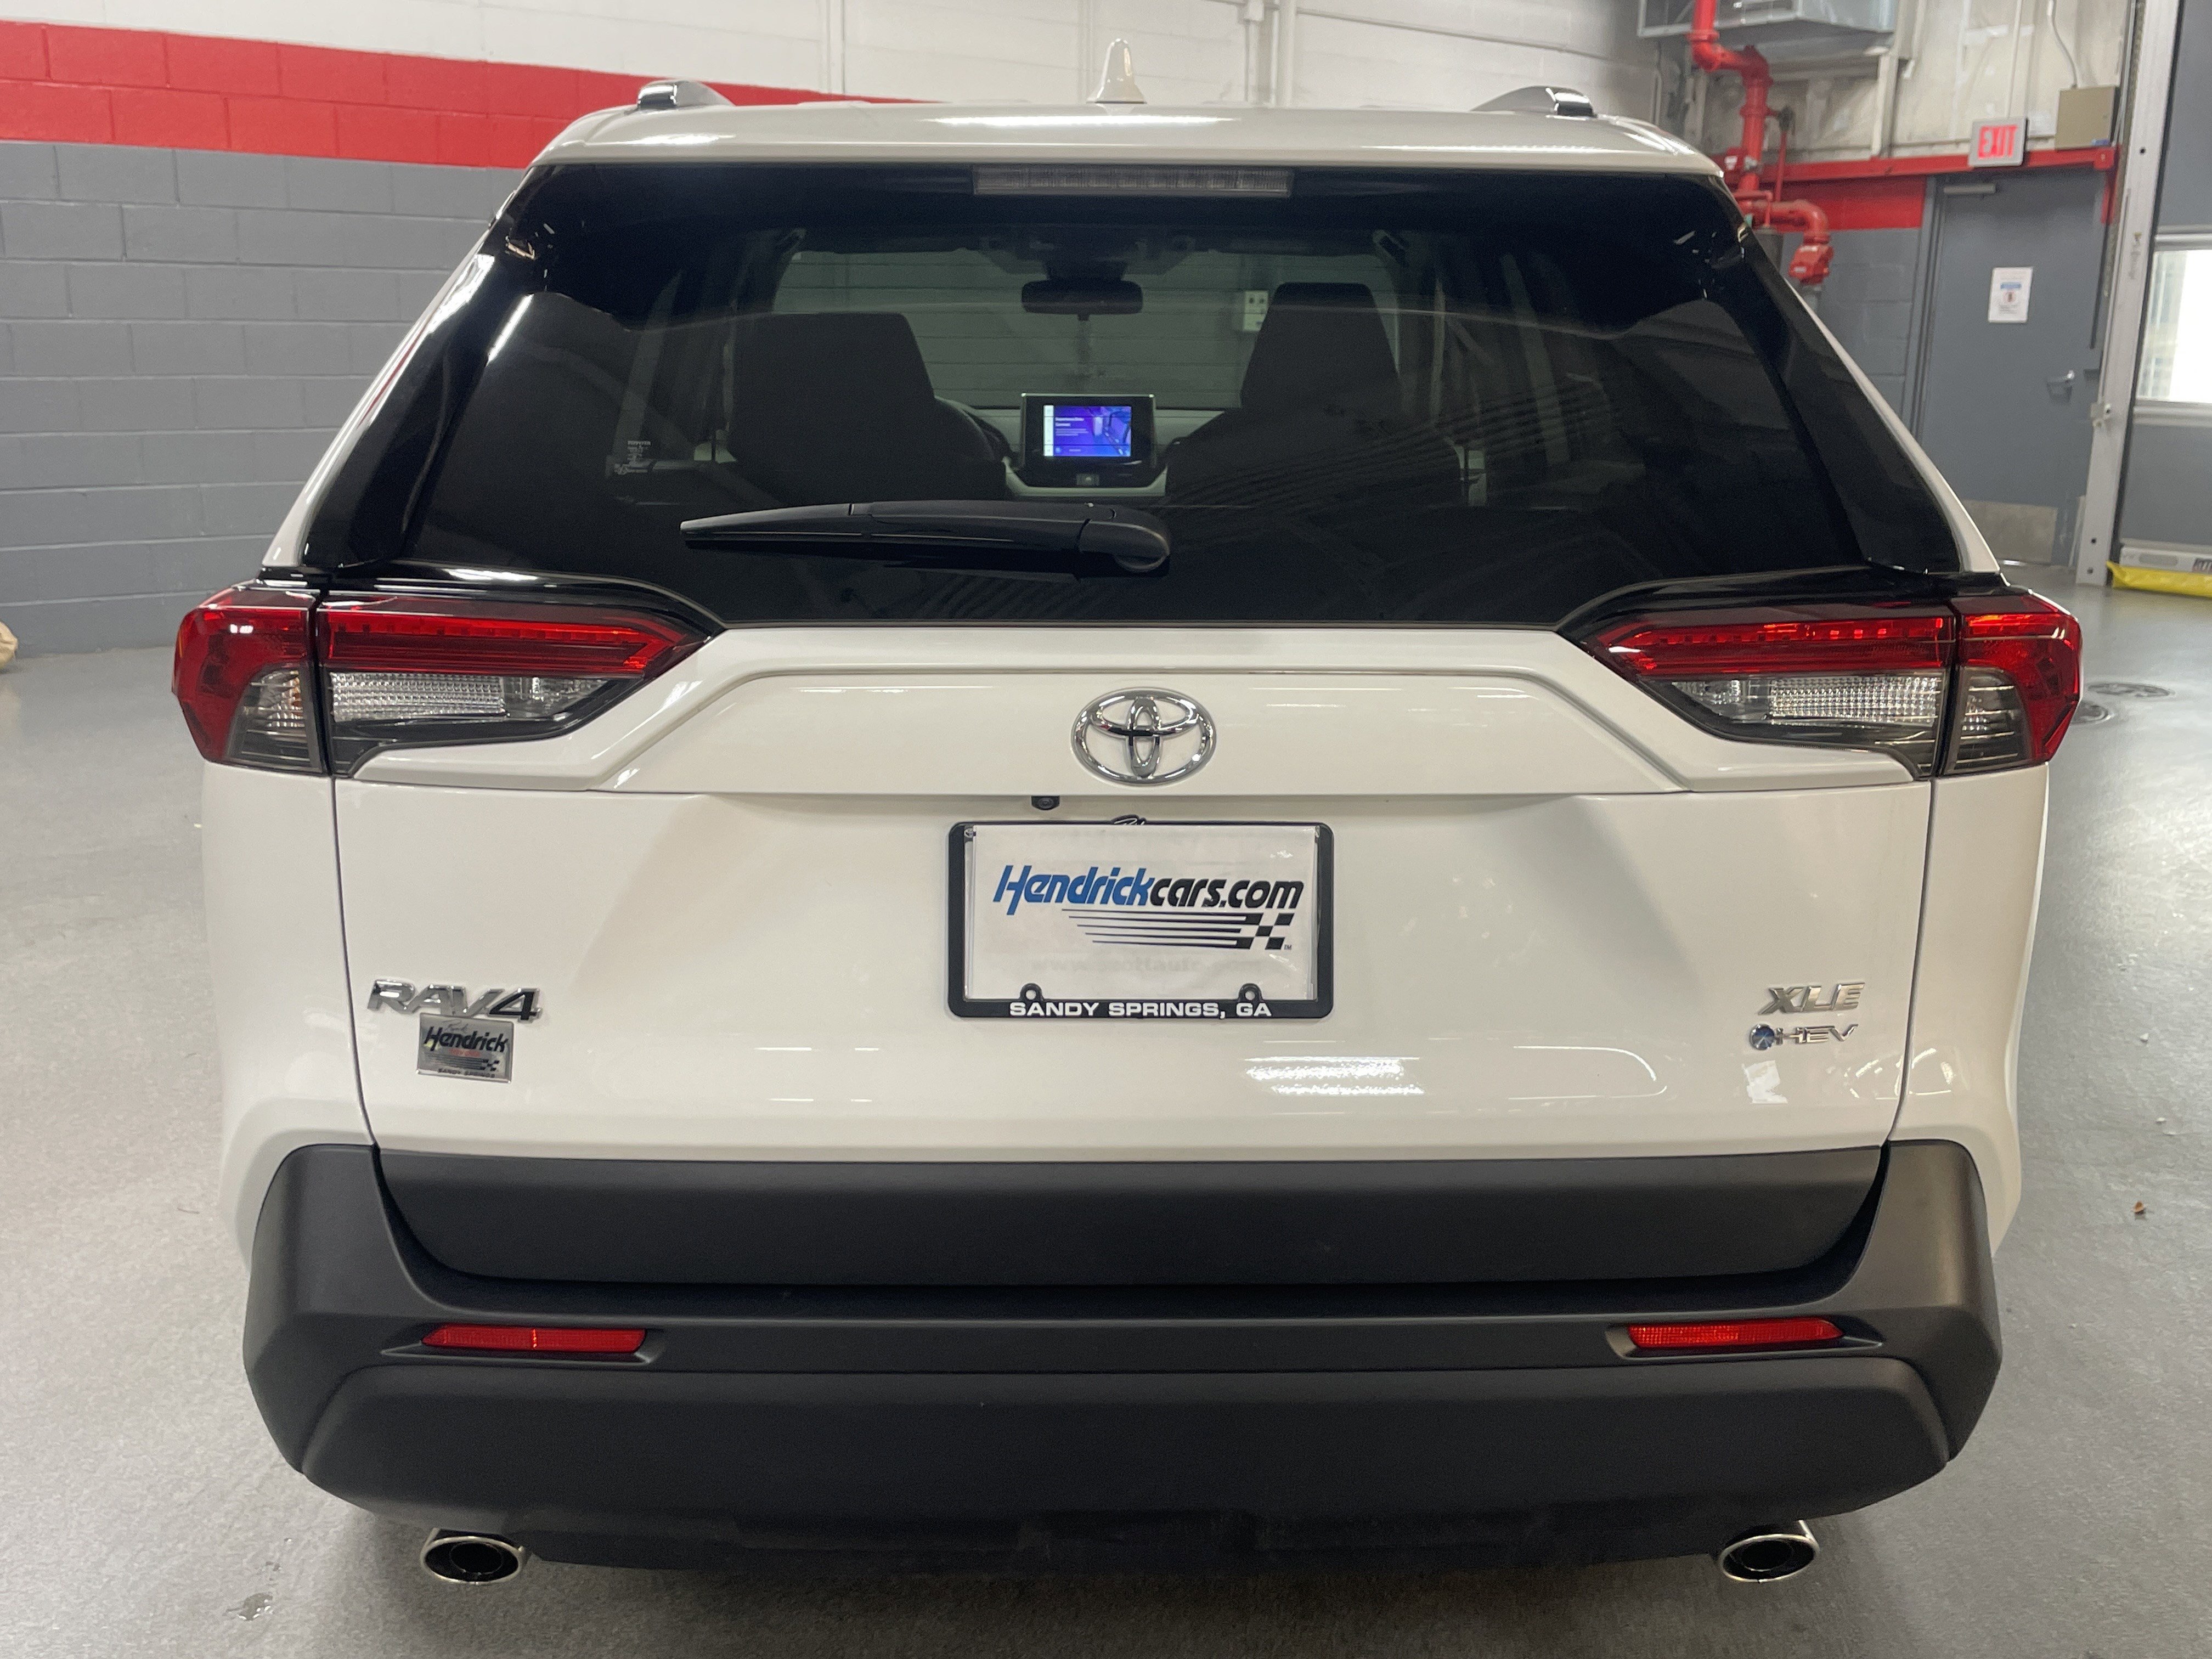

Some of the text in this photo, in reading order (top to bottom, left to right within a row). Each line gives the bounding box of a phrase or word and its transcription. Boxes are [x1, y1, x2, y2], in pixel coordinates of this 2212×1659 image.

[1977, 125, 2017, 159] EXIT
[992, 865, 1305, 915] Hendrickcars.com
[367, 979, 543, 1023] RAV4
[1009, 1001, 1272, 1019] SANDY SPRINGS, GA
[1757, 982, 1866, 1015] XLE
[424, 1025, 509, 1053] Hendrick
[1775, 1023, 1859, 1045] HEV
